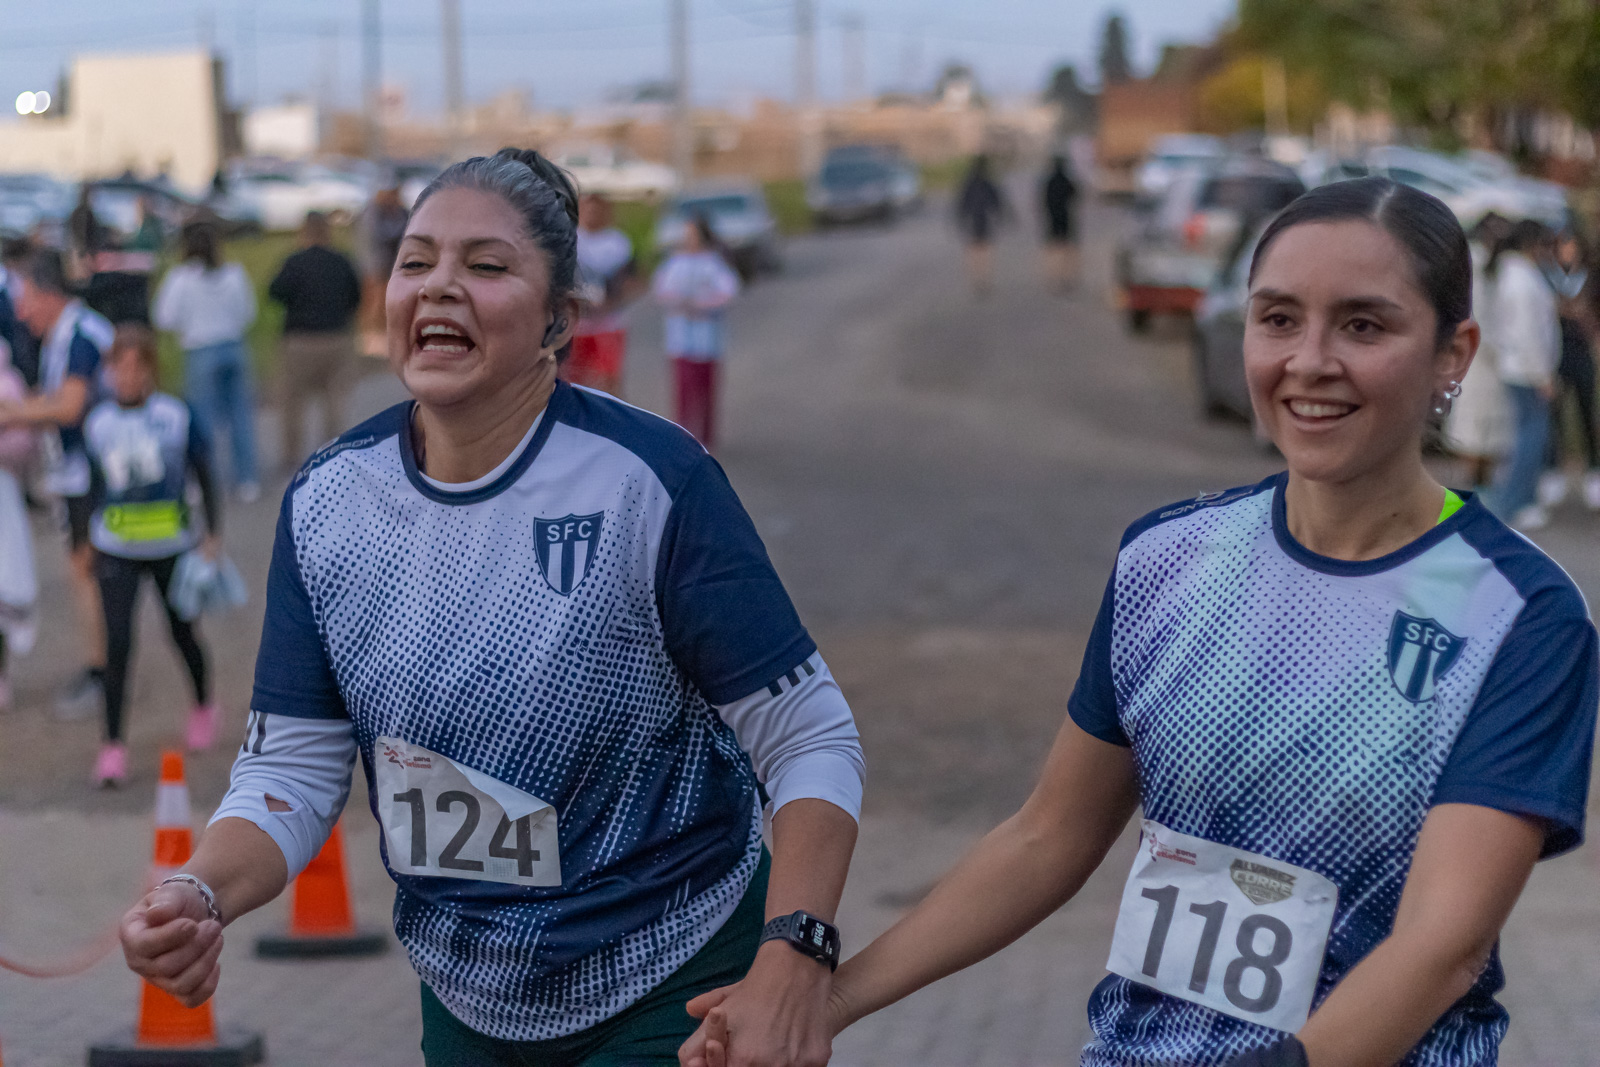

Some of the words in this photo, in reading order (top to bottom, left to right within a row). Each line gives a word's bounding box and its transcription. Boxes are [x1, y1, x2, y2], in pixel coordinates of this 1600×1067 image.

[546, 520, 593, 542] SFC
[1404, 622, 1451, 651] SFC
[393, 788, 541, 878] 124
[1233, 869, 1294, 897] CORRE
[1141, 884, 1293, 1014] 118
